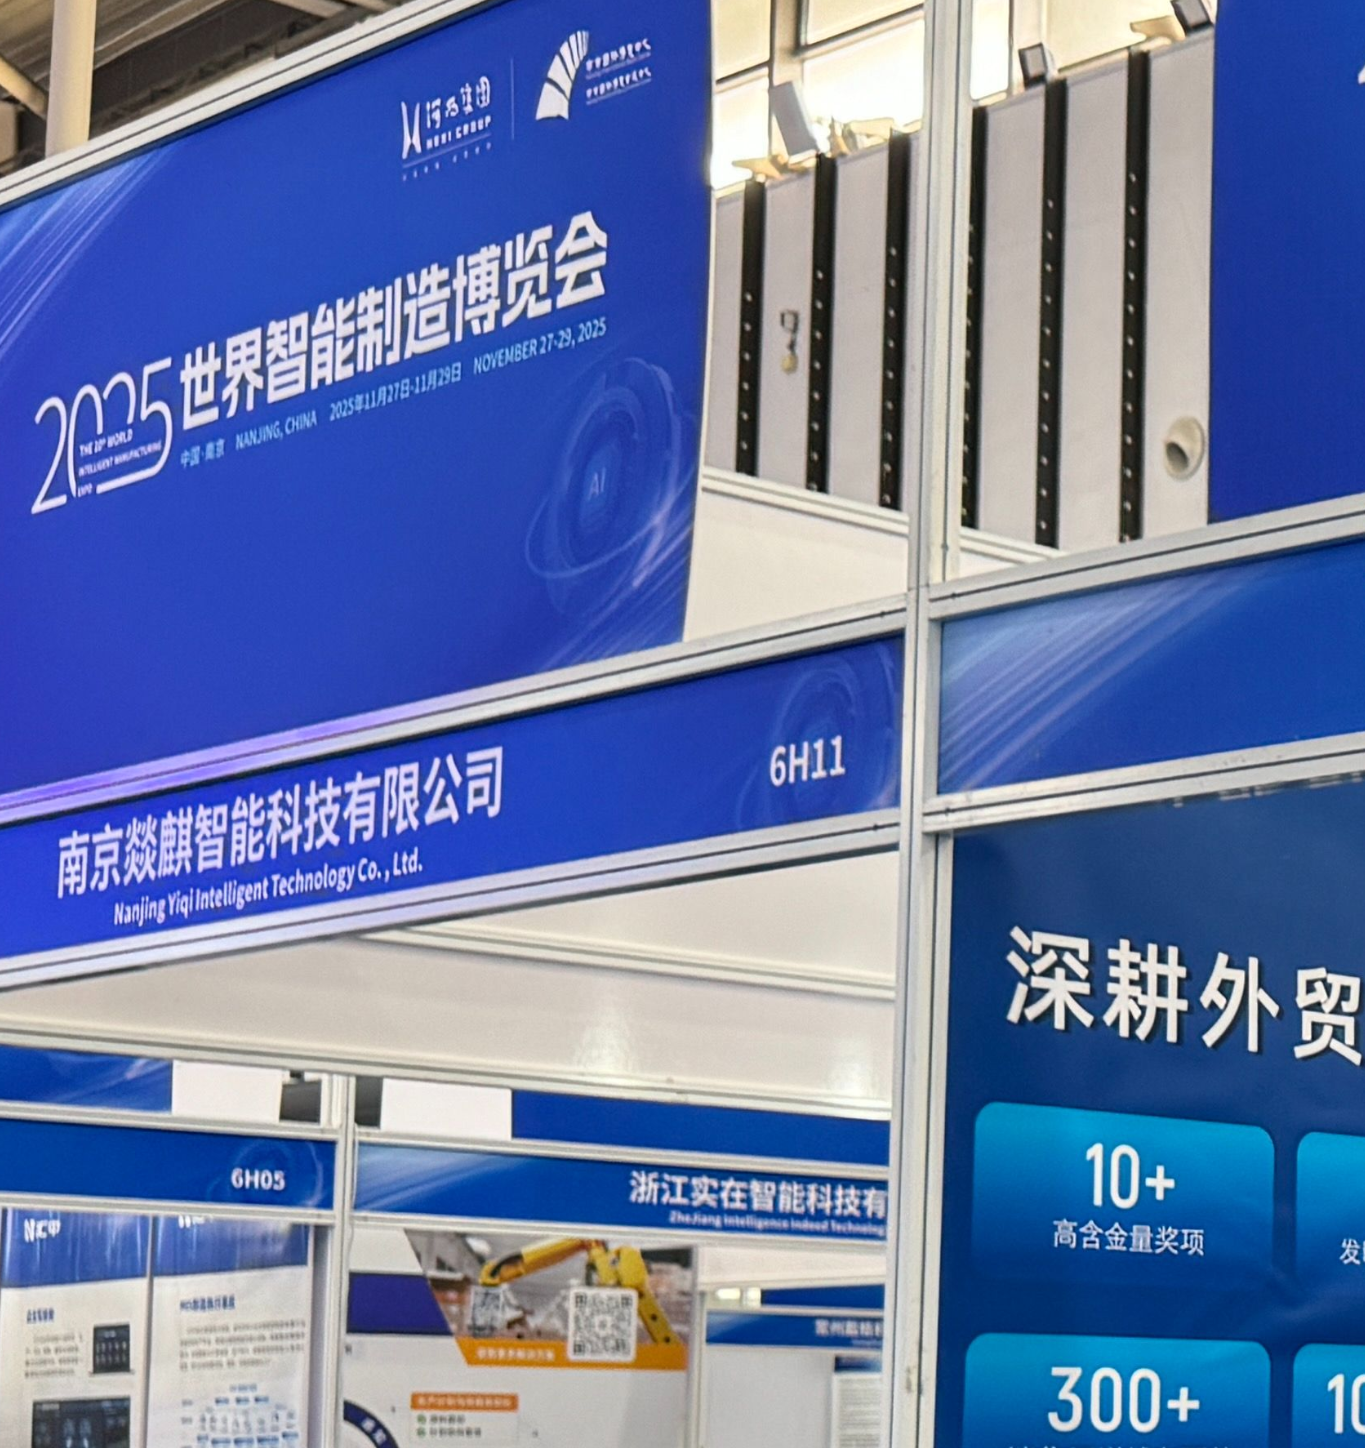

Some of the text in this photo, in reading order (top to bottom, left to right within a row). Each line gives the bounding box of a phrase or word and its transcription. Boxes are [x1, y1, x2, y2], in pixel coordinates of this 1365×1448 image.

[180, 210, 608, 431] 世界智能制造博览会
[235, 421, 284, 451] NANJING,
[284, 410, 318, 435] CHINA
[473, 341, 537, 376] NOVEMBER
[578, 317, 607, 341] 2025
[31, 357, 173, 515] 2025
[768, 736, 847, 788] 6H11
[57, 745, 504, 899] 南京燚麒智能科技有限公司
[114, 893, 166, 927] Nanjing
[167, 890, 196, 920] Yiqi
[195, 875, 269, 911] Intelligent
[270, 860, 356, 898] Technology
[393, 846, 424, 875] Ltd.
[230, 1166, 287, 1193] 6H05
[629, 1169, 888, 1220] 浙江实在智能科技有
[1085, 1142, 1176, 1209] 10+
[1052, 1218, 1206, 1256] 高含金量奖项
[1047, 1366, 1201, 1433] 300+
